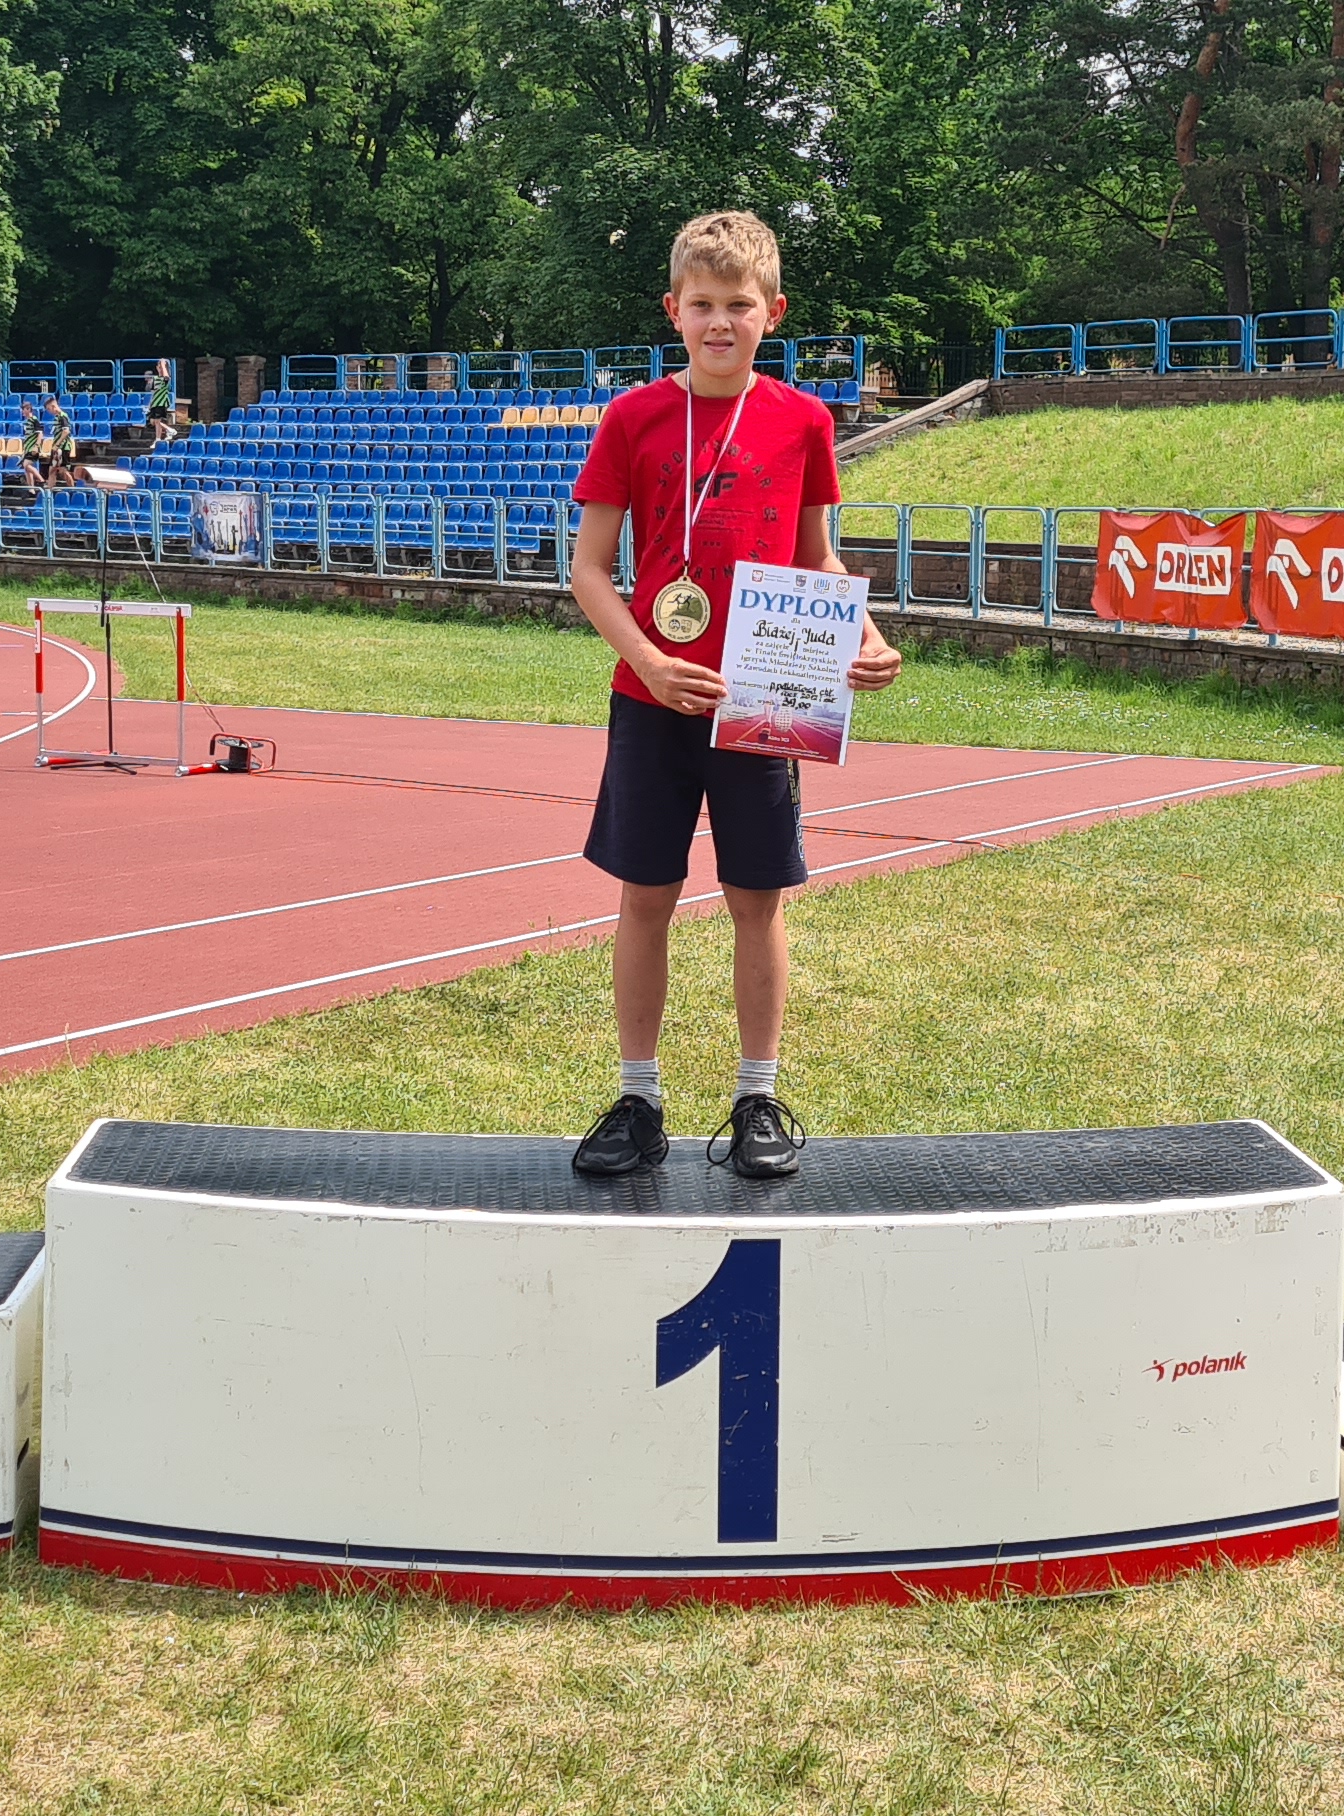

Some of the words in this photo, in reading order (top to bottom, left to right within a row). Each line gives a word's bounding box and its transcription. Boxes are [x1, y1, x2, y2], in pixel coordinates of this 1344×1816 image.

[1158, 550, 1226, 587] ORLEN
[738, 588, 858, 624] DYPLOM
[1171, 1350, 1248, 1383] polanik
[655, 1238, 781, 1545] 1
